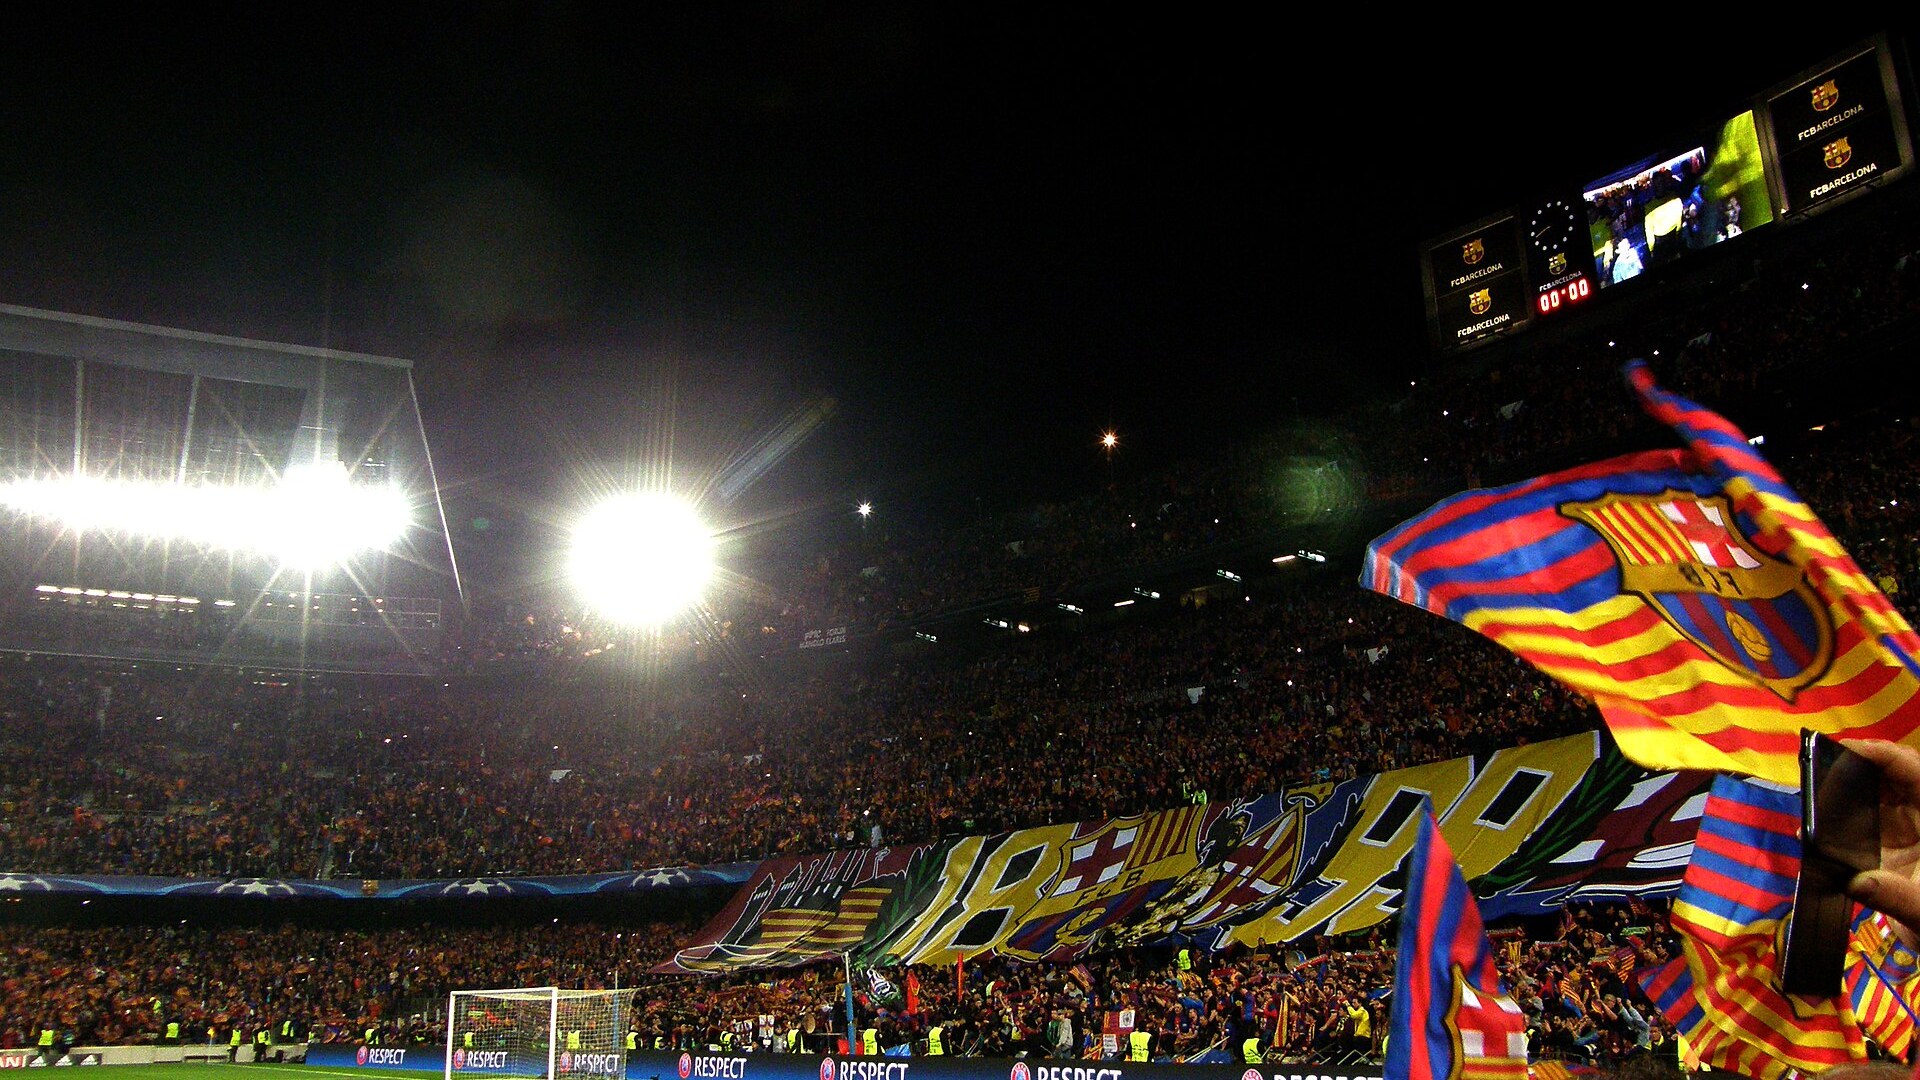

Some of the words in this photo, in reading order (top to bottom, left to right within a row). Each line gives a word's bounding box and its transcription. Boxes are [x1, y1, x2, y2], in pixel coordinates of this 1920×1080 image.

[368, 1049, 406, 1064] RESPECT
[467, 1051, 508, 1069] RESPECT
[574, 1054, 620, 1073] RESPECT
[694, 1056, 747, 1079] RESPECT
[840, 1061, 909, 1080] RESPECT
